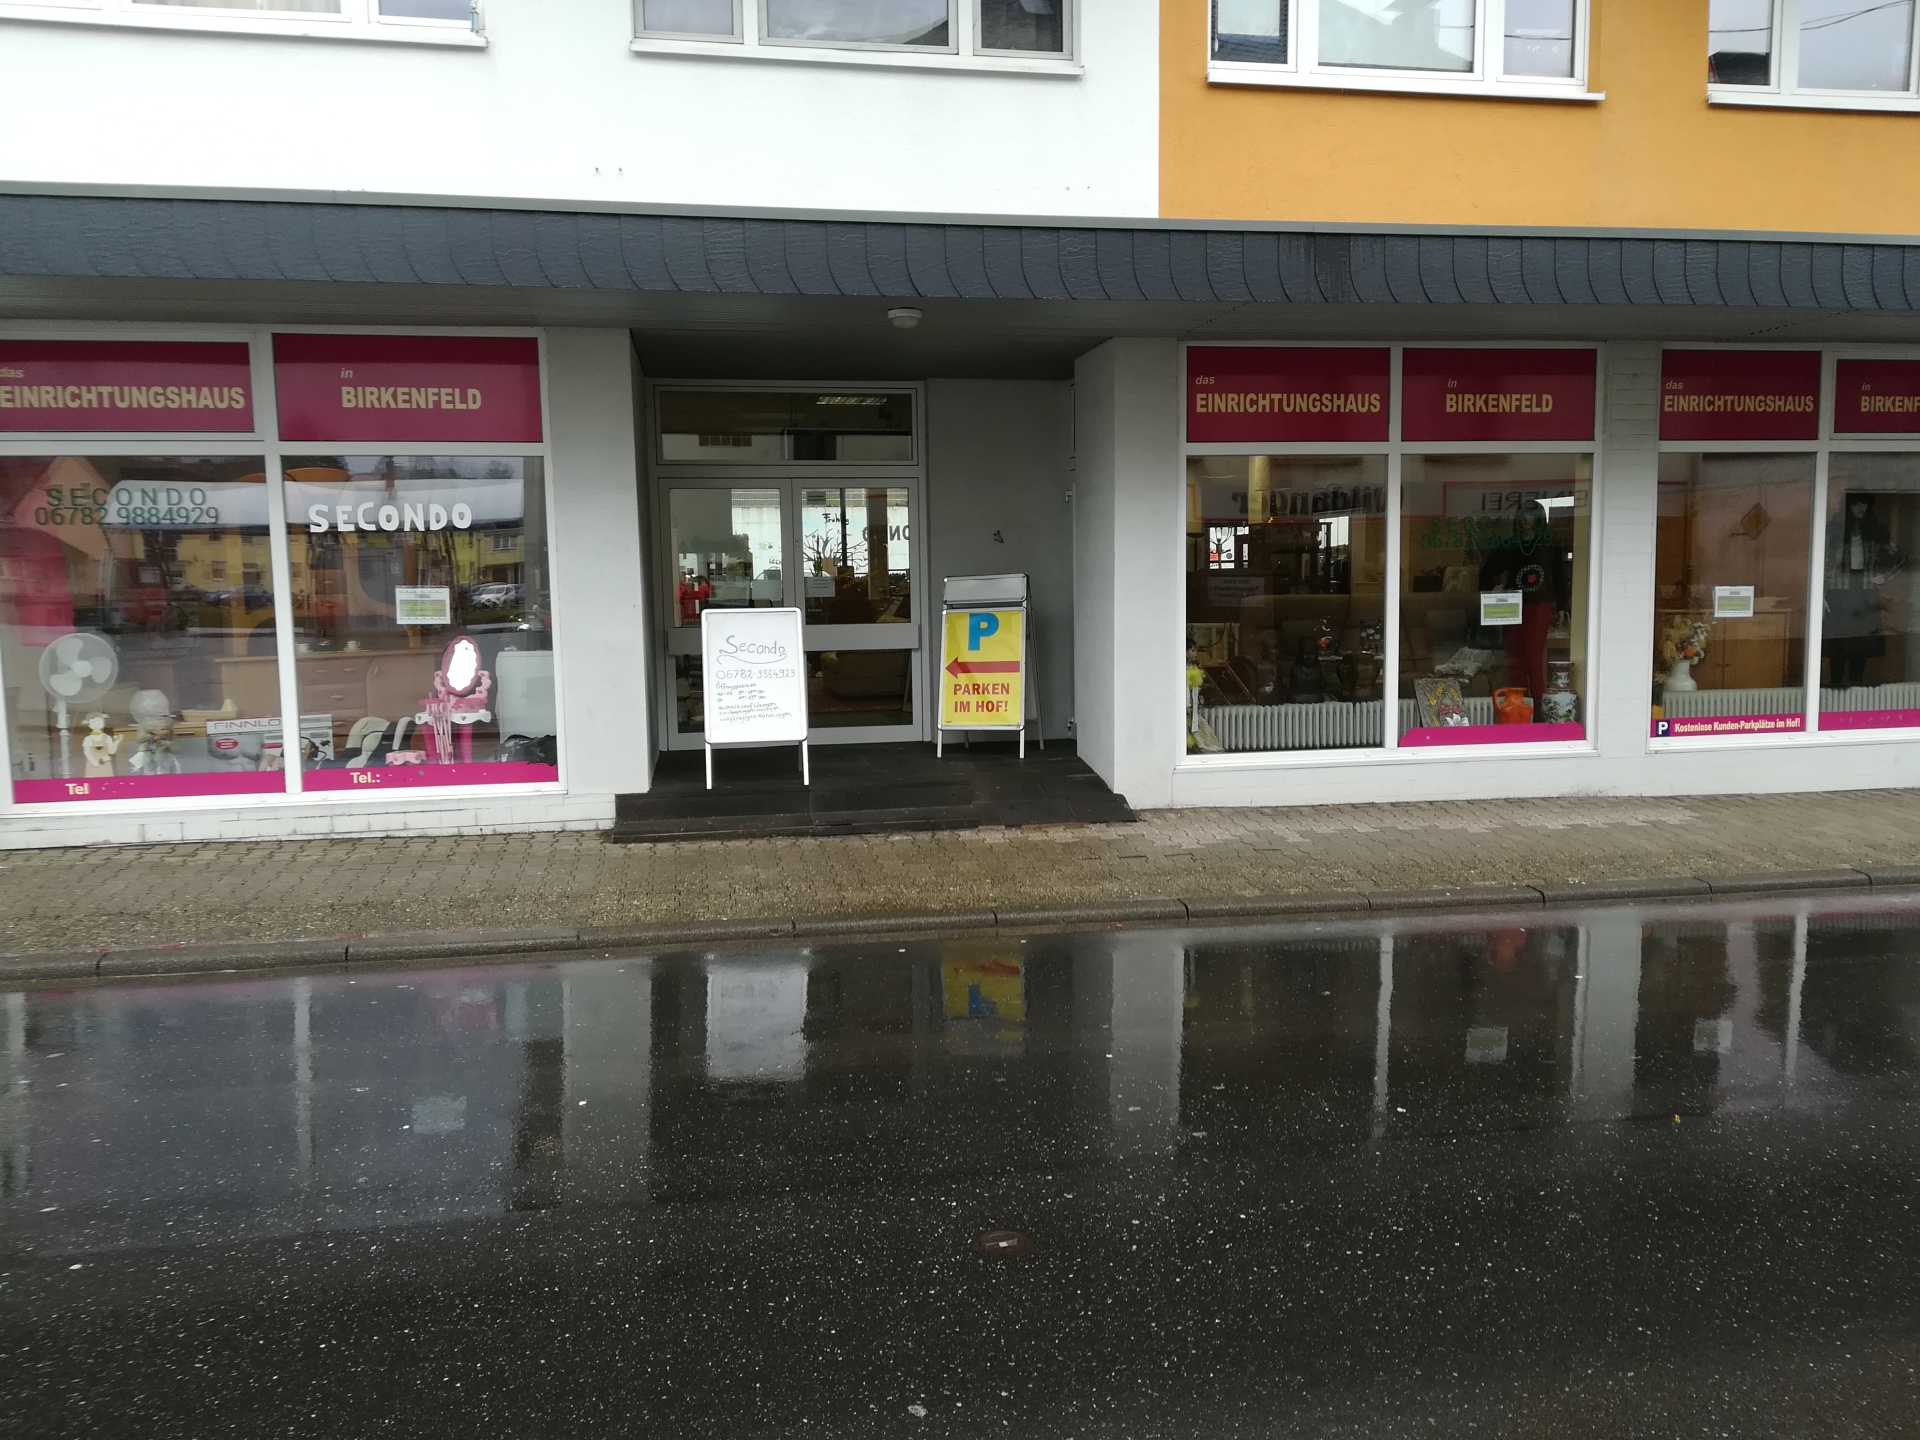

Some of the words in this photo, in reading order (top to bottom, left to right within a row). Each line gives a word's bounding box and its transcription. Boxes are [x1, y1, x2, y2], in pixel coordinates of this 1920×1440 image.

[340, 367, 354, 379] in
[1195, 375, 1216, 386] das
[1447, 378, 1458, 389] in
[1665, 380, 1684, 391] das
[1861, 381, 1872, 392] in
[0, 385, 245, 410] EINRICHTUNGSHAUS
[341, 386, 483, 411] BIRKENFELD
[1195, 393, 1382, 414] EINRICHTUNGSHAUS
[1445, 393, 1554, 414] BIRKENFELD
[1663, 394, 1815, 413] EINRICHTUNGSHAUS
[45, 486, 208, 507] SECONDO
[34, 506, 109, 526] 06782
[117, 505, 220, 526] 9884929
[307, 501, 473, 533] SECONDO
[968, 613, 1000, 651] P
[718, 634, 786, 655] Secondo
[953, 683, 1009, 696] PARKEN
[953, 700, 971, 713] IM
[975, 700, 1009, 713] HOF!
[1658, 721, 1669, 735] P
[1674, 721, 1713, 733] Kostenlose
[1713, 719, 1776, 732] Kunden-Parkplätze
[1776, 718, 1785, 728] im
[1786, 717, 1801, 728] Hof!
[350, 772, 381, 784] Tel.:
[64, 782, 90, 796] Tel
